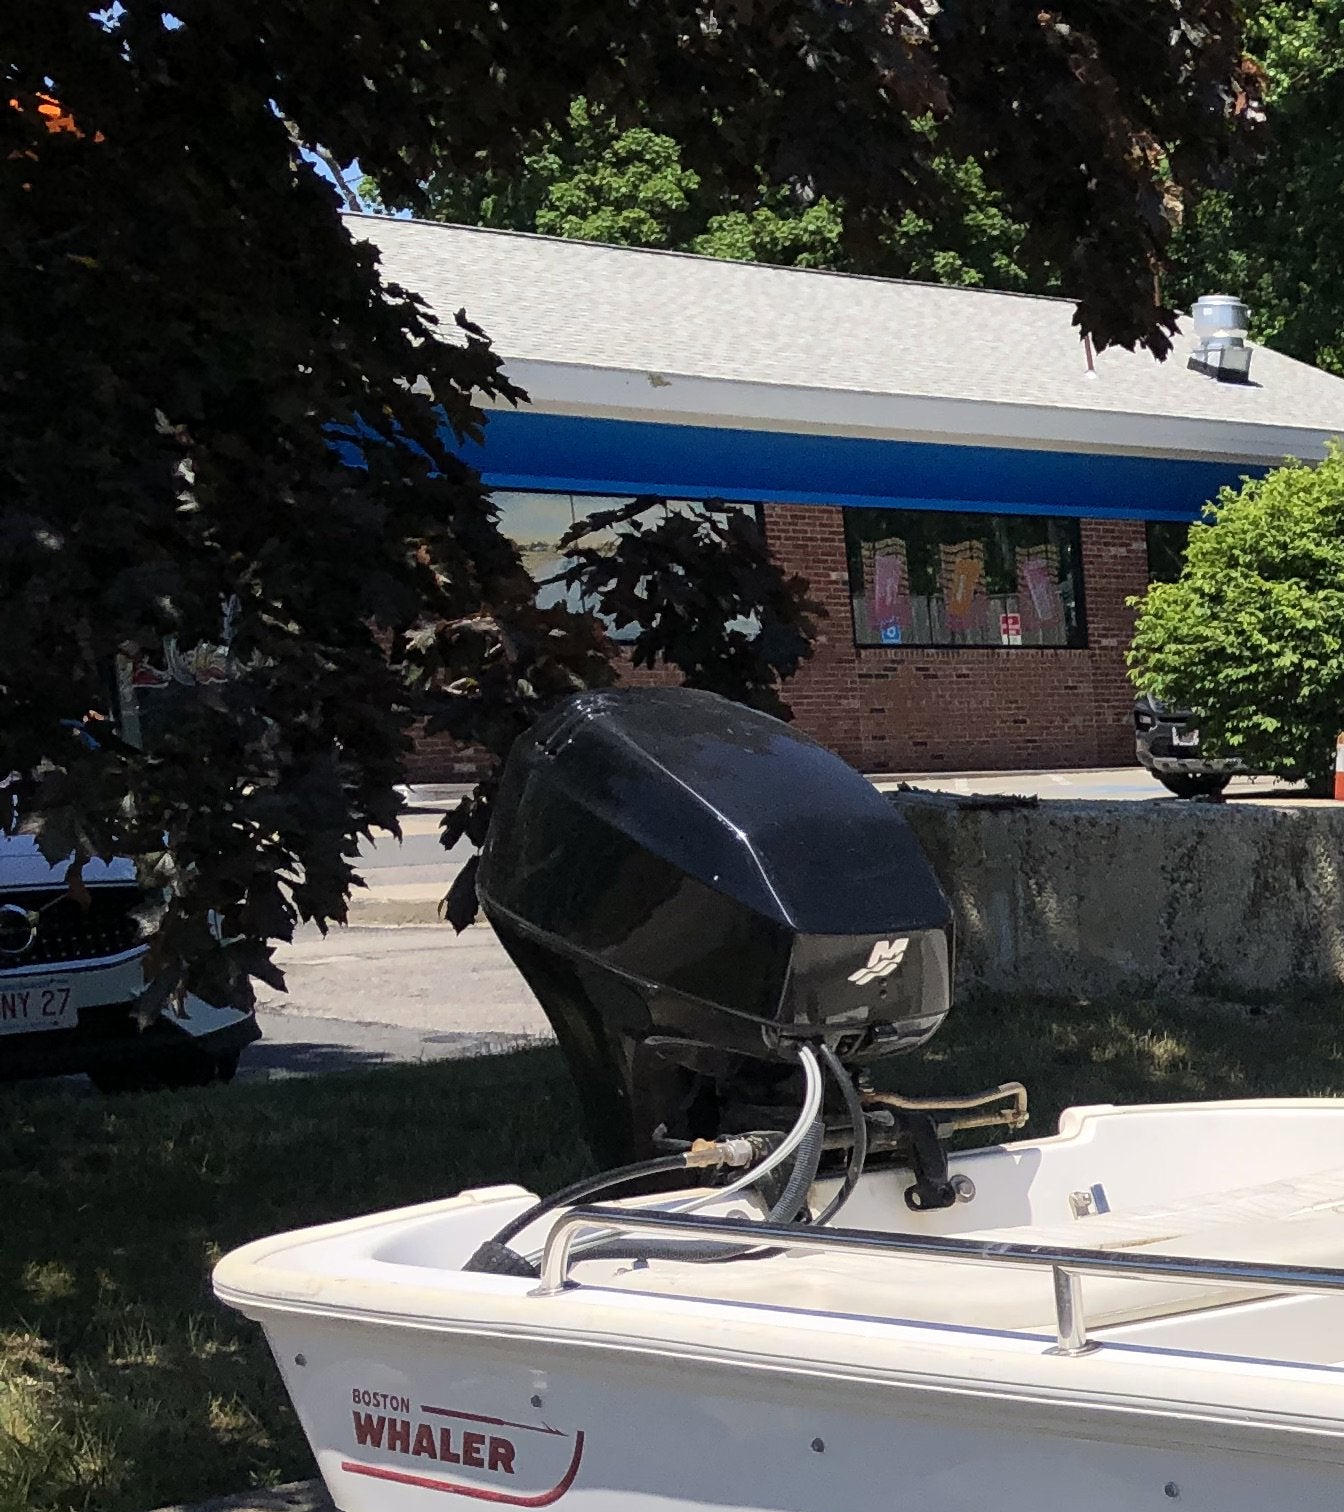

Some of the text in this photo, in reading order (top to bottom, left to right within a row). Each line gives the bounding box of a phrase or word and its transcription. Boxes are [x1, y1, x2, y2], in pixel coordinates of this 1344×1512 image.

[41, 987, 71, 1016] 27
[352, 1388, 410, 1413] BOSTON
[352, 1410, 516, 1475] WHALER
